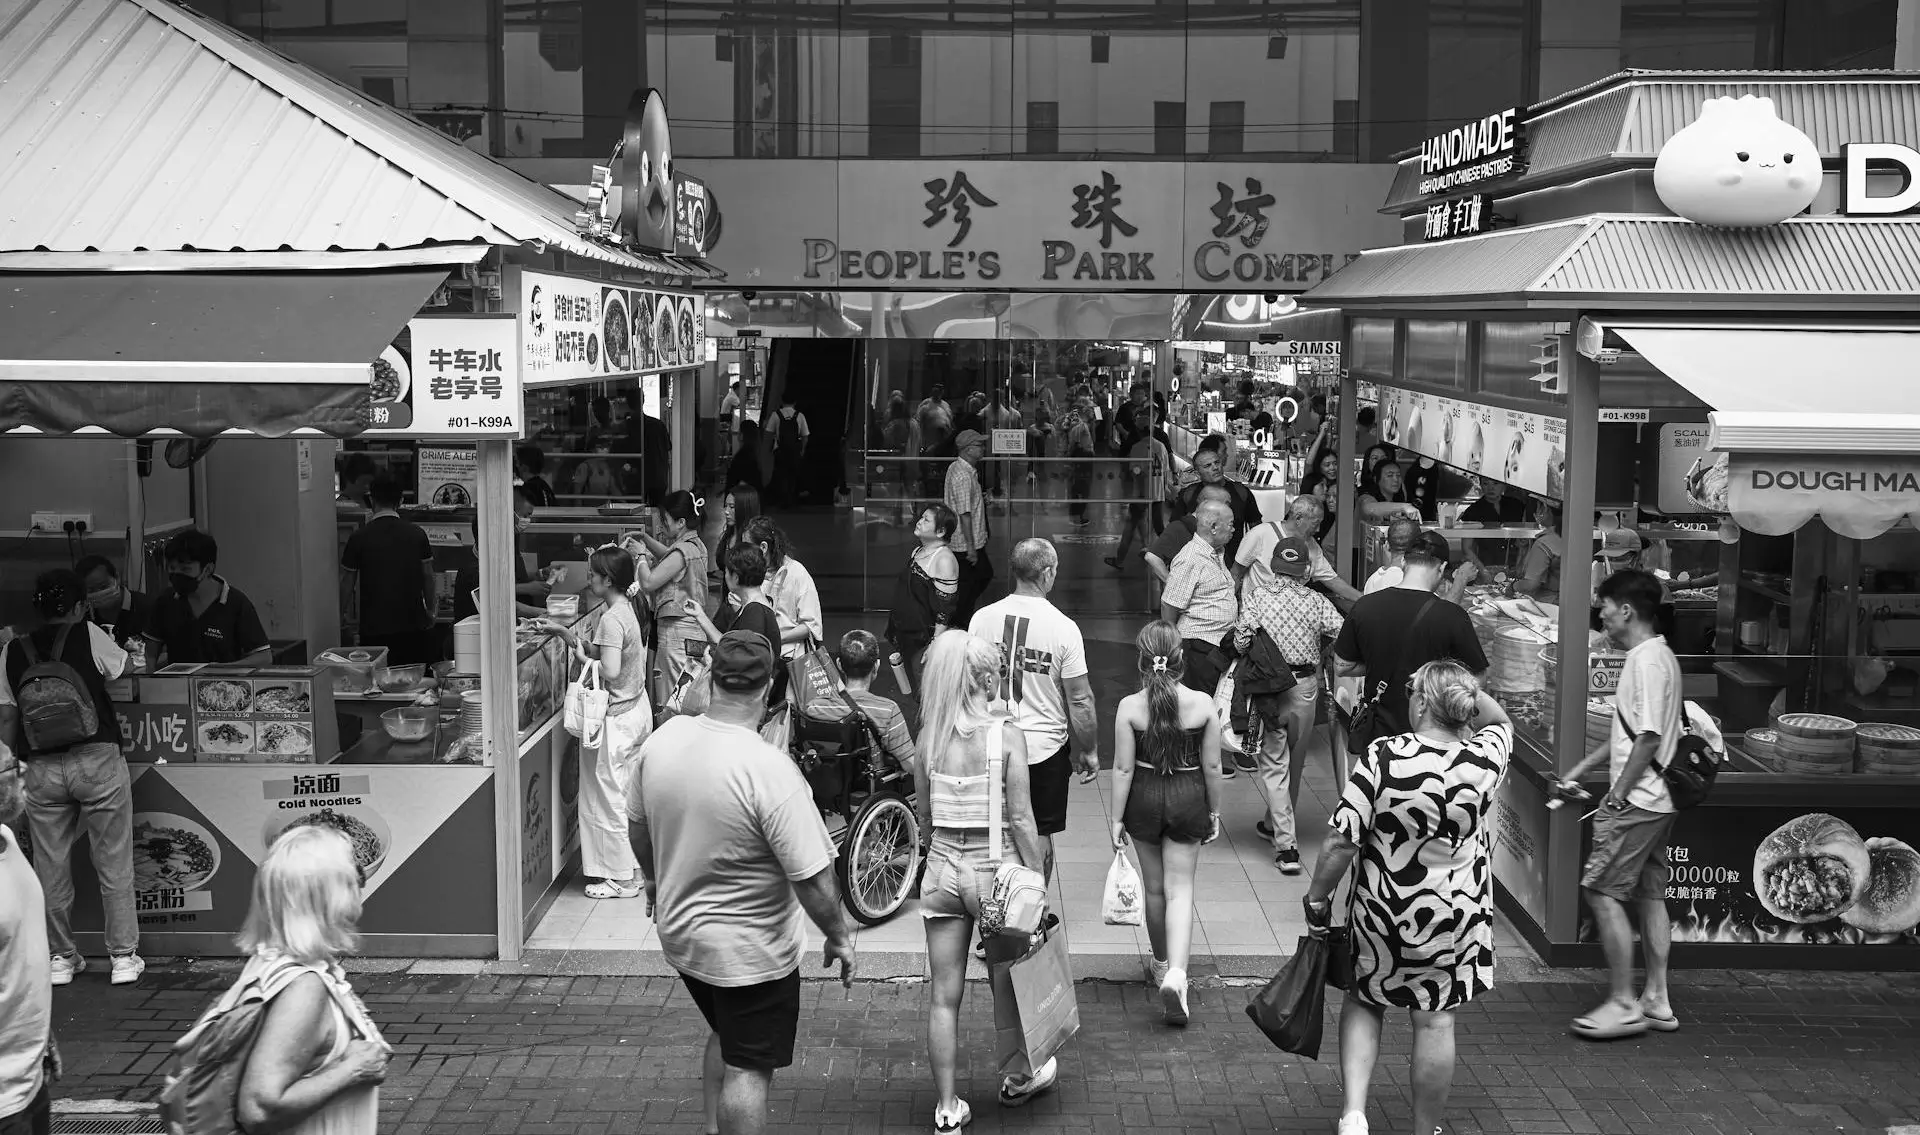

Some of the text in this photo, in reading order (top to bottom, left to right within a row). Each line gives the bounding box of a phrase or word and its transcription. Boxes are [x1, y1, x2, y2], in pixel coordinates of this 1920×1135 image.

[1420, 107, 1516, 175] HANDMADE
[1419, 155, 1513, 195] HIGH QUALITY CHINESE PASTRIES
[923, 171, 1276, 248] 珍珠坊
[1424, 194, 1482, 240] 好面食 手工做
[1194, 241, 1361, 282] COMPL
[555, 331, 585, 362] 好吃不贵
[429, 348, 502, 372] 牛车水
[430, 376, 502, 400] 老字号
[448, 417, 513, 428] #01-K99A
[421, 451, 451, 460] CRIME
[1674, 439, 1701, 448] 葱油饼
[1752, 470, 1866, 491] DOUGH
[294, 773, 340, 795] 凉面
[278, 797, 362, 809] Cold Noodles
[1665, 886, 1717, 900] 皮脆馅香
